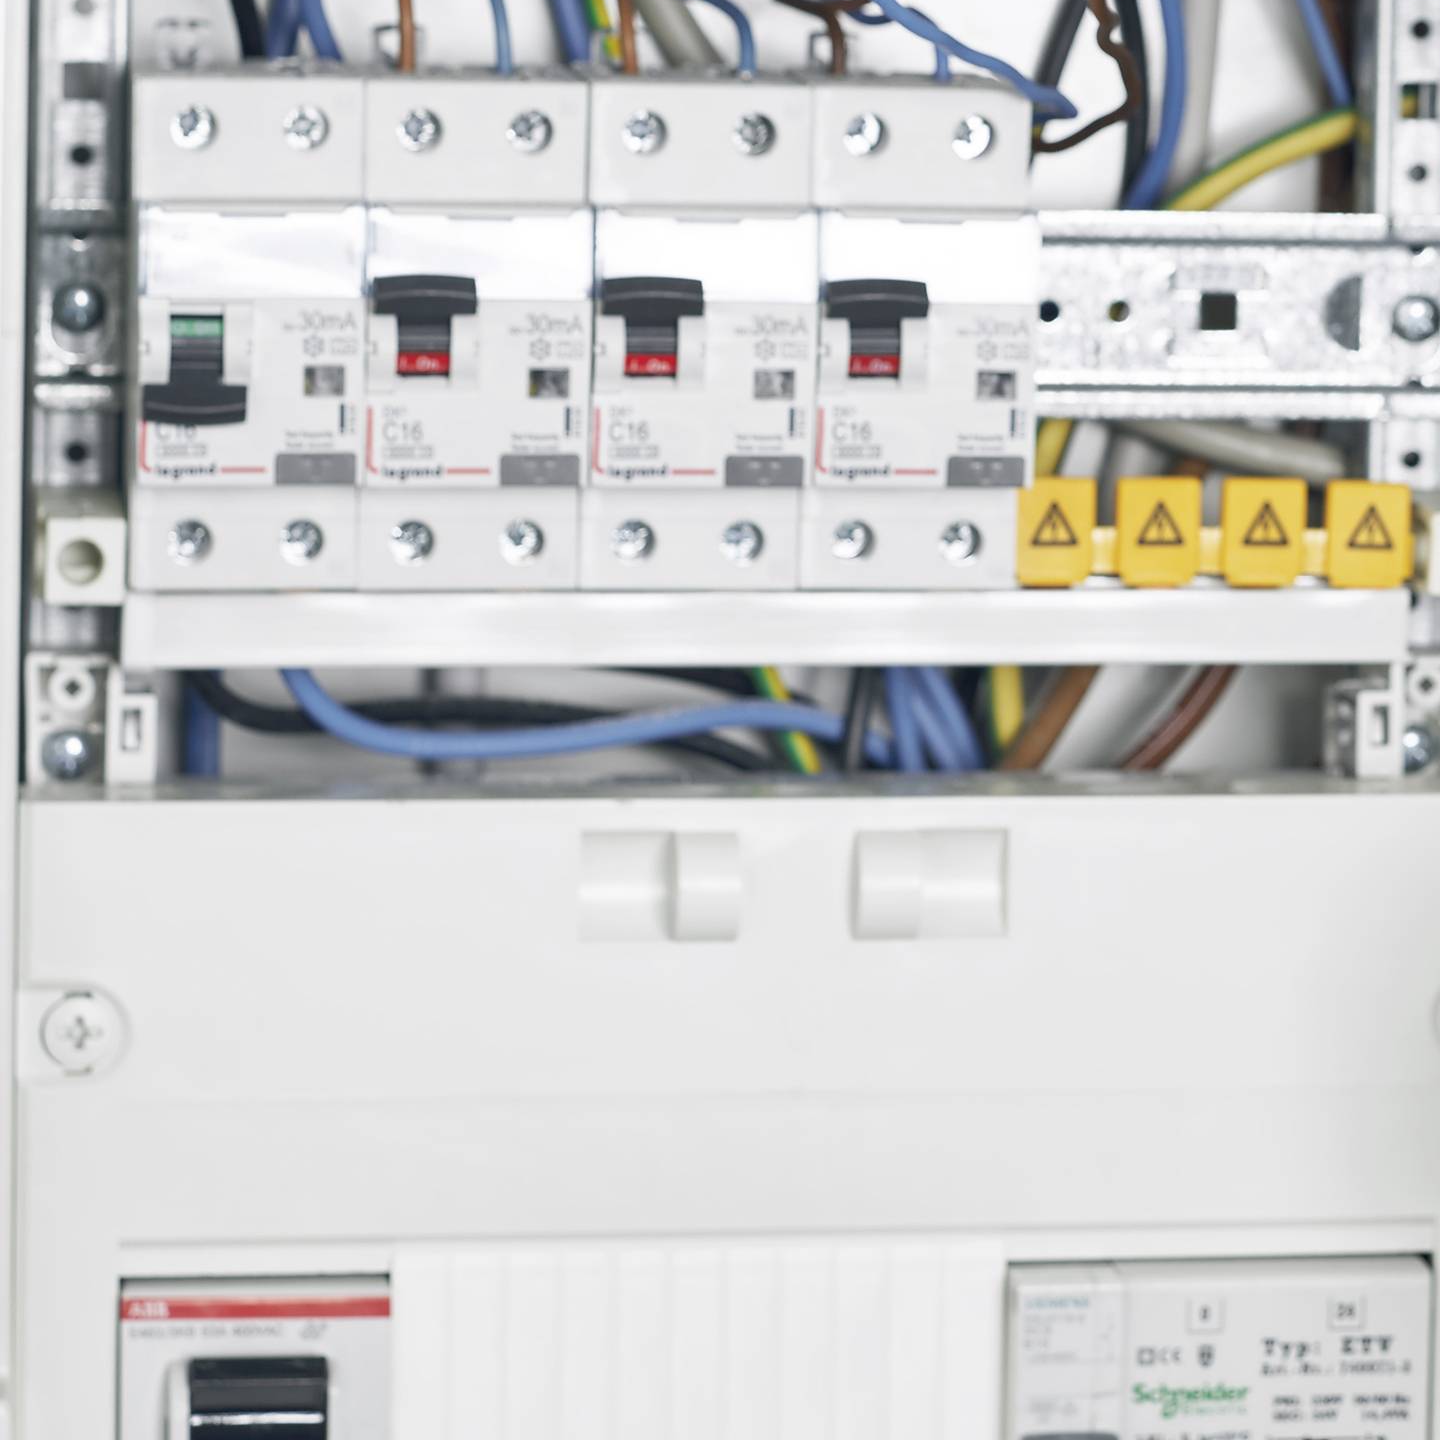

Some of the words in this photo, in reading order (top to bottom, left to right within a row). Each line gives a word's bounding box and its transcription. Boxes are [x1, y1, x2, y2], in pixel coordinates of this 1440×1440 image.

[382, 421, 424, 442] C16
[608, 421, 650, 442] C16
[831, 421, 872, 442] C16
[155, 463, 218, 479] legrand
[381, 463, 444, 480] legrand
[608, 463, 669, 480] legrand
[831, 462, 891, 479] legrand
